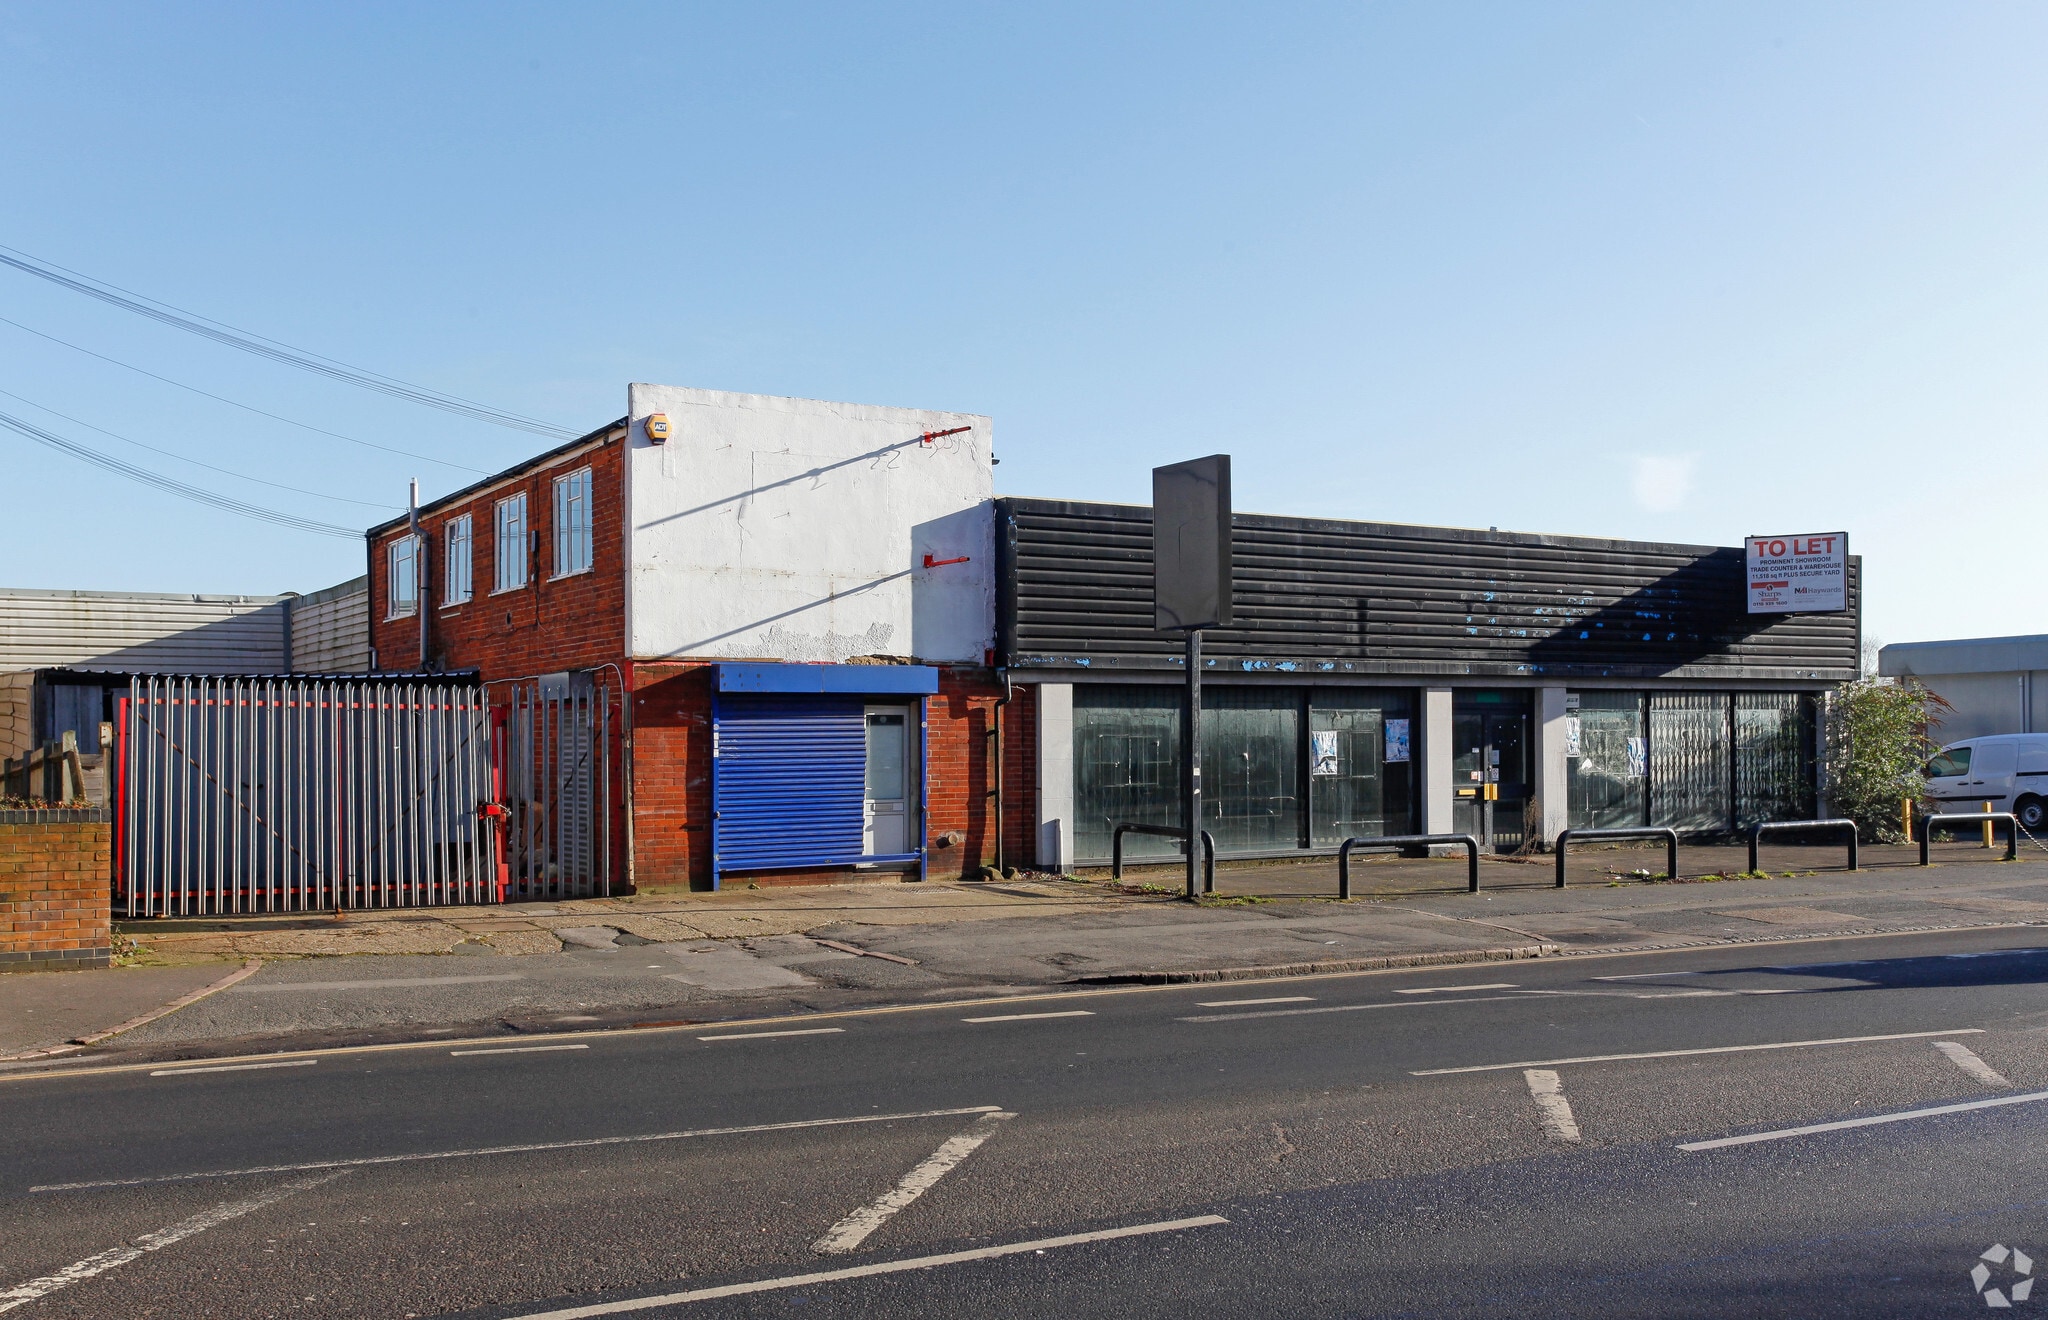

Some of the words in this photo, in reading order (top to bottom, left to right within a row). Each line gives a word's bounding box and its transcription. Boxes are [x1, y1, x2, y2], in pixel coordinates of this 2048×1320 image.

[1754, 540, 1786, 557] TO
[1793, 537, 1836, 555] LET
[1804, 562, 1841, 570] WAREHOUSE
